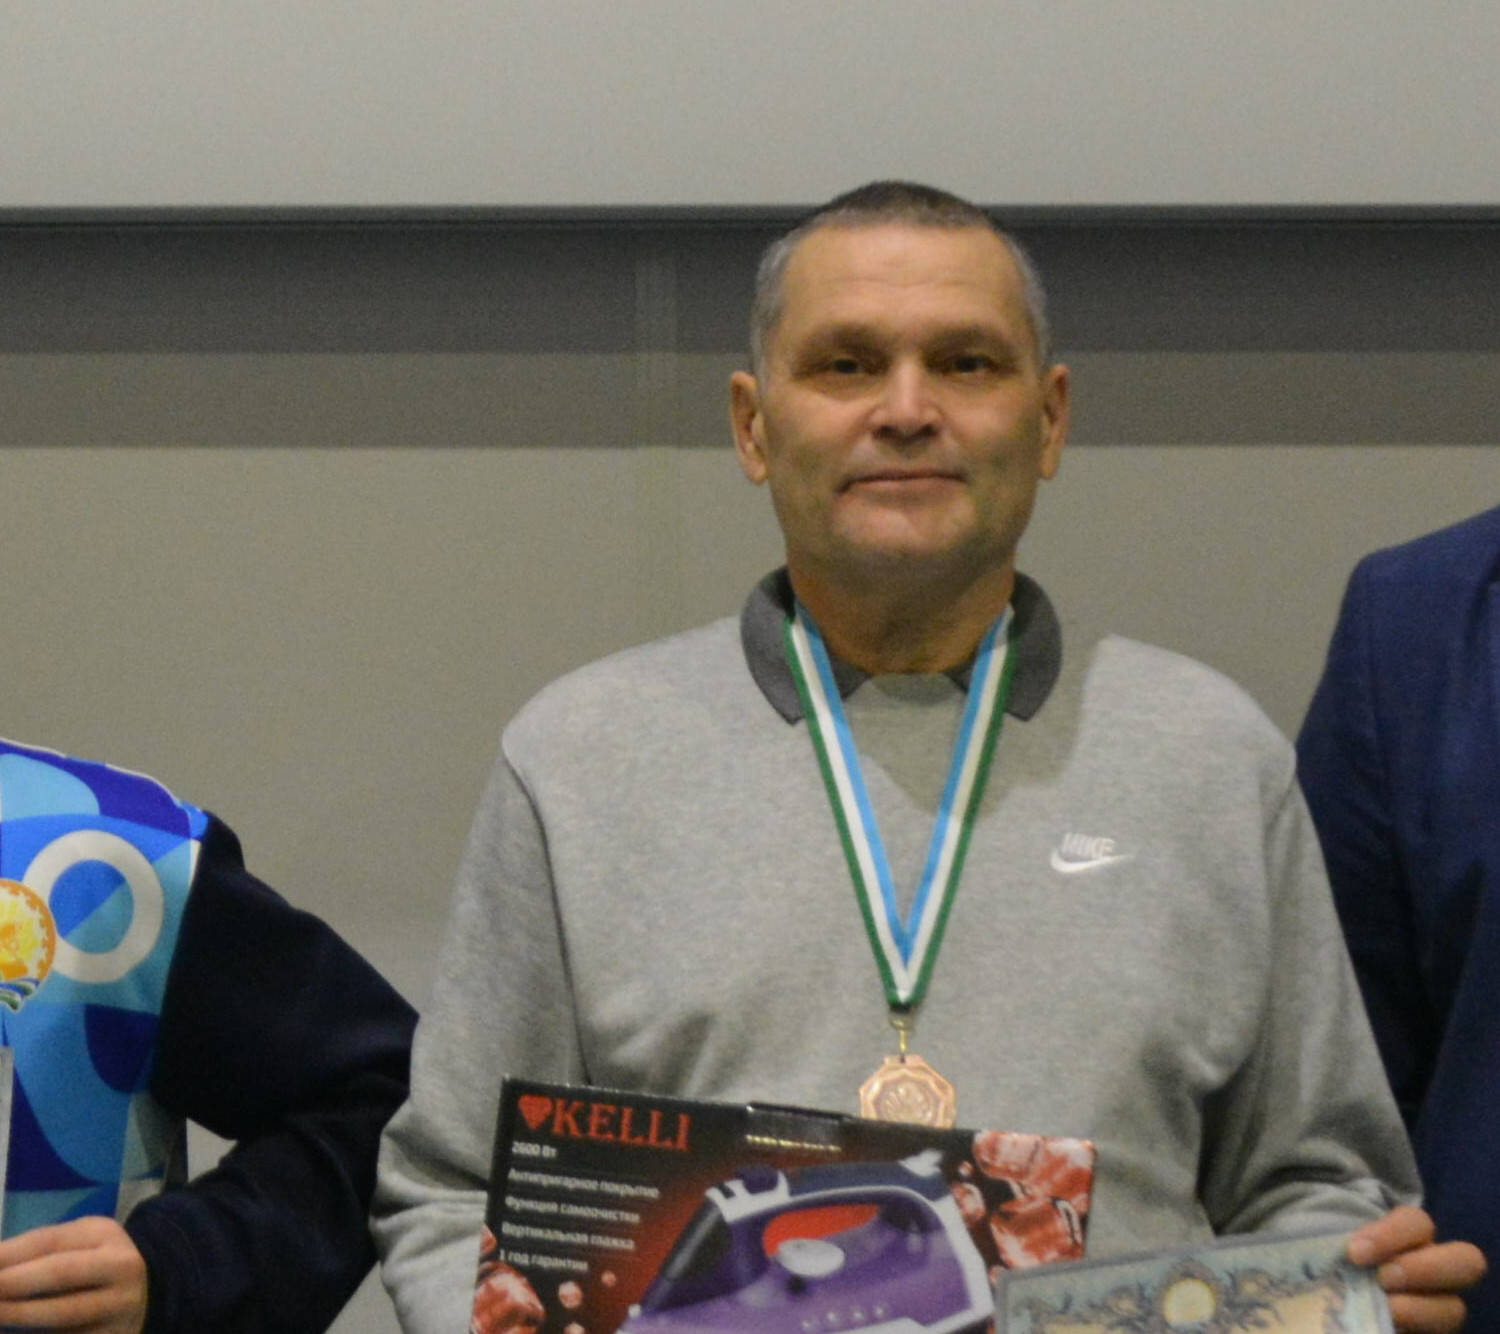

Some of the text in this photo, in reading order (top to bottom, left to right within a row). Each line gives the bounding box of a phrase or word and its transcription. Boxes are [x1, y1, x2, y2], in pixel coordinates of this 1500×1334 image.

[1062, 832, 1115, 859] NIKE
[552, 1098, 692, 1151] KELLI
[508, 1168, 660, 1199] Антипригарное покрытие
[505, 1196, 640, 1224] Функция самоочистки
[502, 1221, 635, 1250] Вертикальная глажка
[508, 1252, 530, 1266] год
